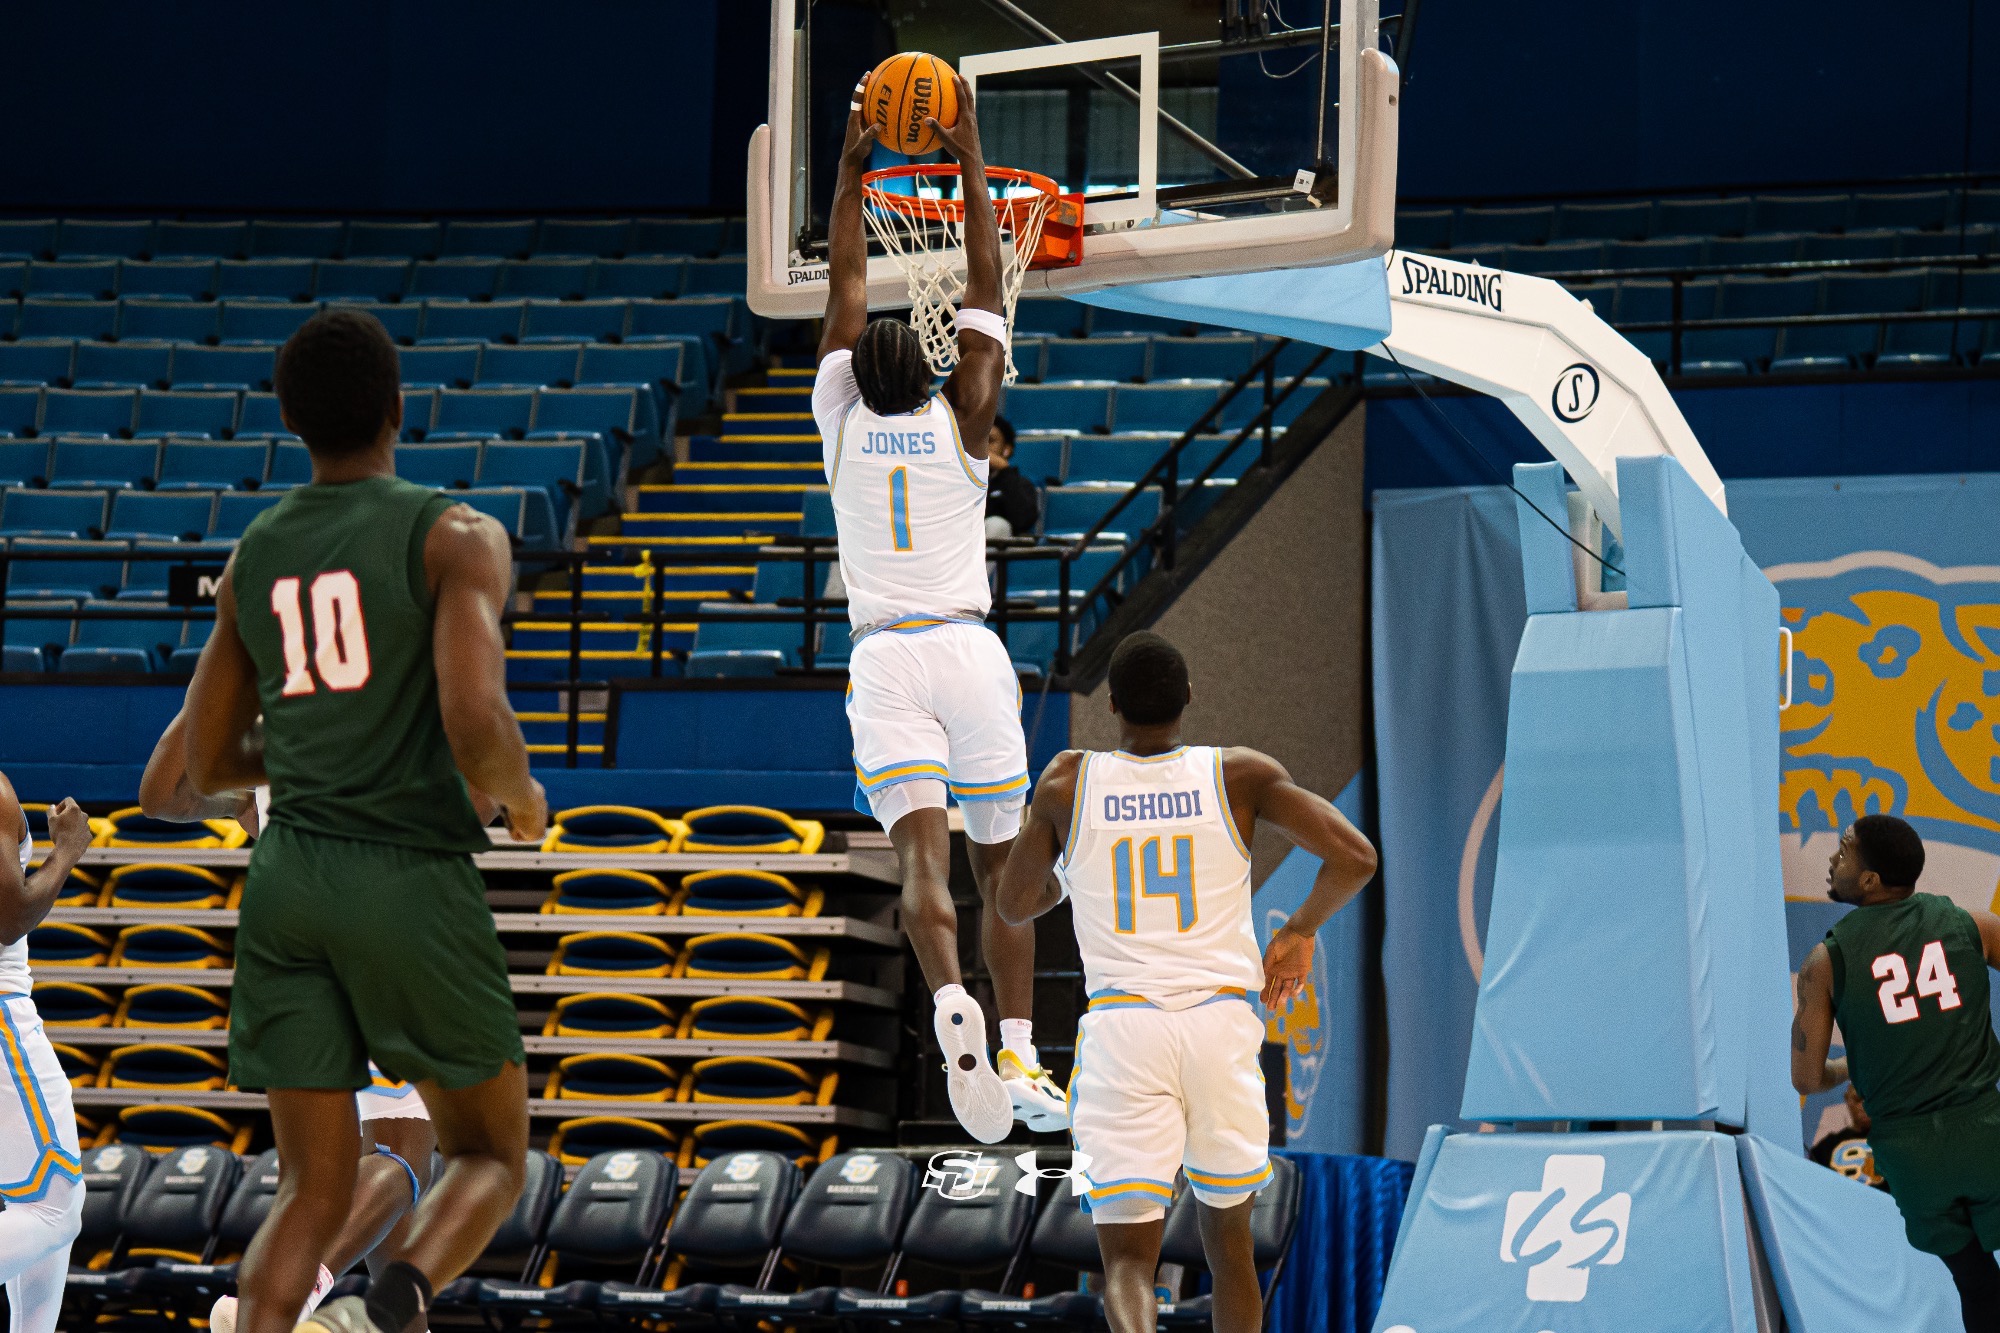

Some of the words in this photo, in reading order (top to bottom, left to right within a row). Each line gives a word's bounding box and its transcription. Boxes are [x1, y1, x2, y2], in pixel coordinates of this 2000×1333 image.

[906, 77, 932, 142] Wilson
[1402, 256, 1502, 312] SPALDING
[861, 431, 936, 455] JONES
[888, 466, 913, 552] 1
[270, 569, 372, 697] 10
[1104, 789, 1202, 822] OSHODI
[1111, 835, 1199, 934] 14
[1870, 939, 1962, 1025] 24
